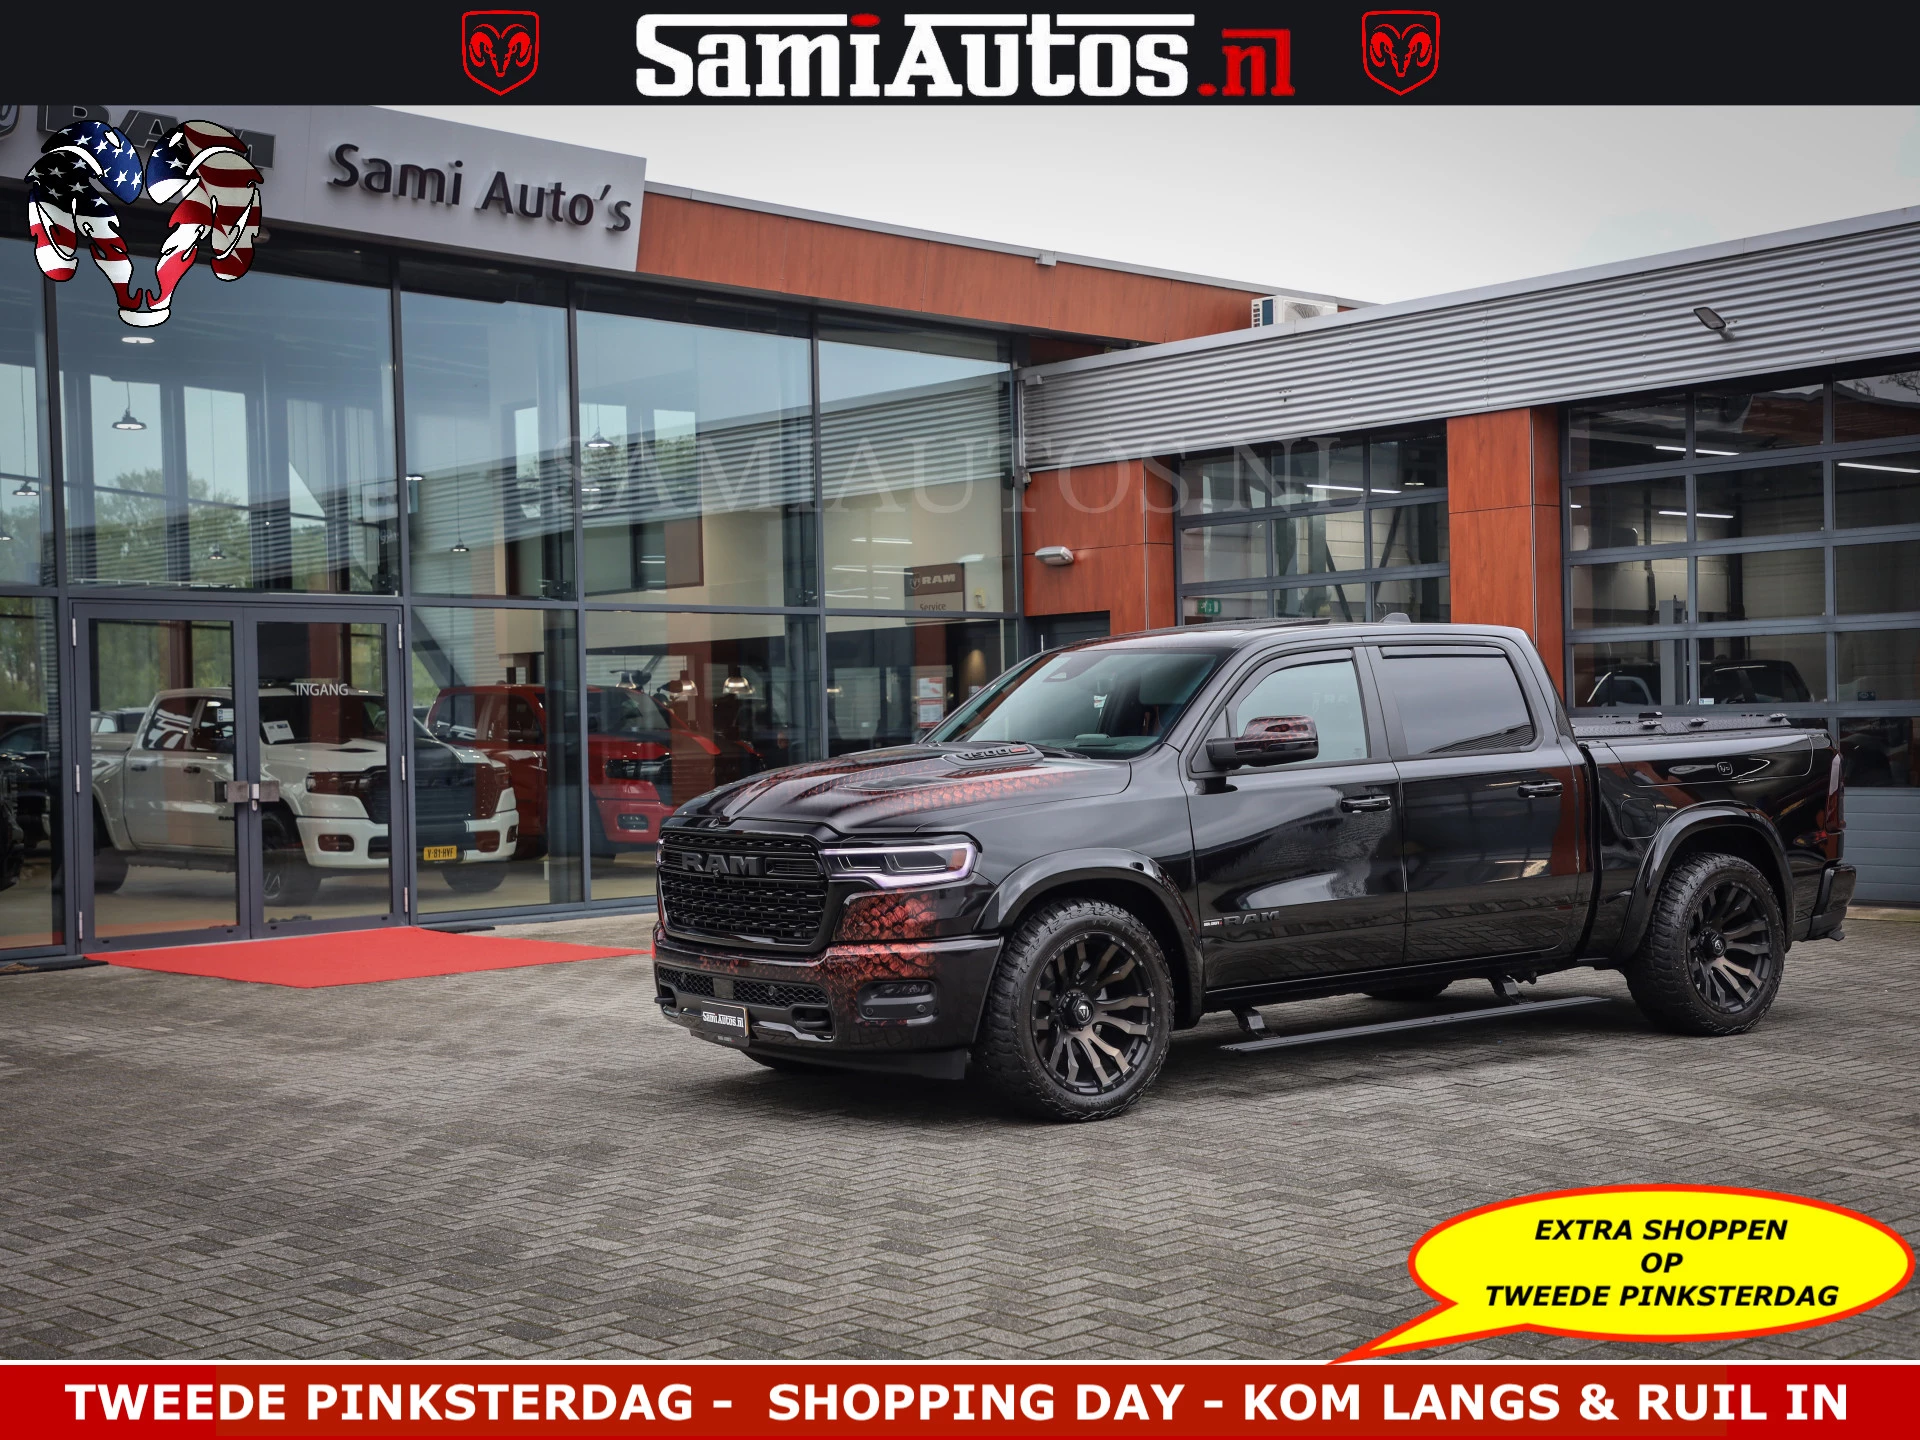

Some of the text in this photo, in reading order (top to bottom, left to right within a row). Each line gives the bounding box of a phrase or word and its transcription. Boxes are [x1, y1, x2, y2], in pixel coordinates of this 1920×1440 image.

[327, 142, 632, 232] Sami Auto's
[922, 574, 956, 585] RAM
[920, 602, 947, 611] Service
[295, 683, 349, 696] INGANG
[963, 748, 1009, 760] 1500
[681, 852, 759, 876] RAM
[1223, 911, 1280, 926] RAM
